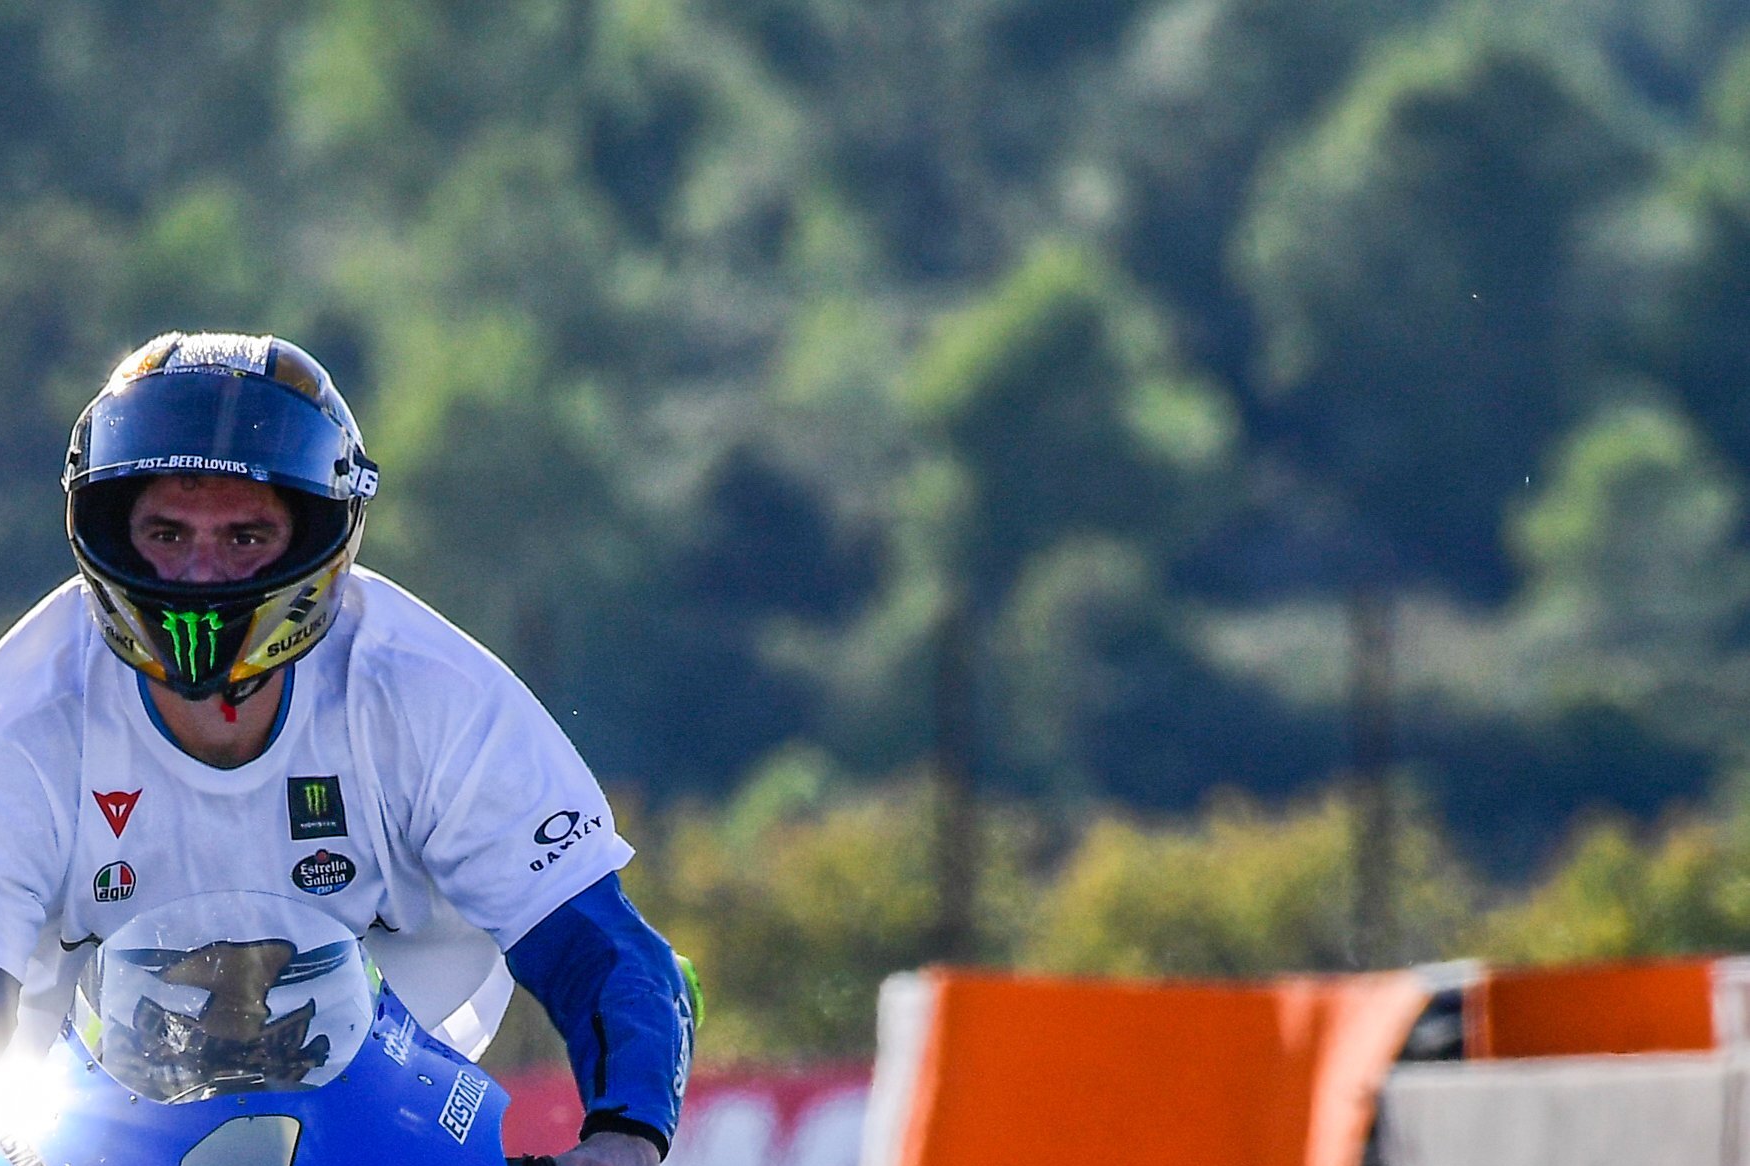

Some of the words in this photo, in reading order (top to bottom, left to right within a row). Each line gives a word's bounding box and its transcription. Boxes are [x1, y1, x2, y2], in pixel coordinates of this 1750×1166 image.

[267, 611, 327, 657] SUZUKI
[299, 860, 347, 876] Estrella
[302, 872, 346, 886] Galicia
[442, 1072, 486, 1140] ECSTAR
